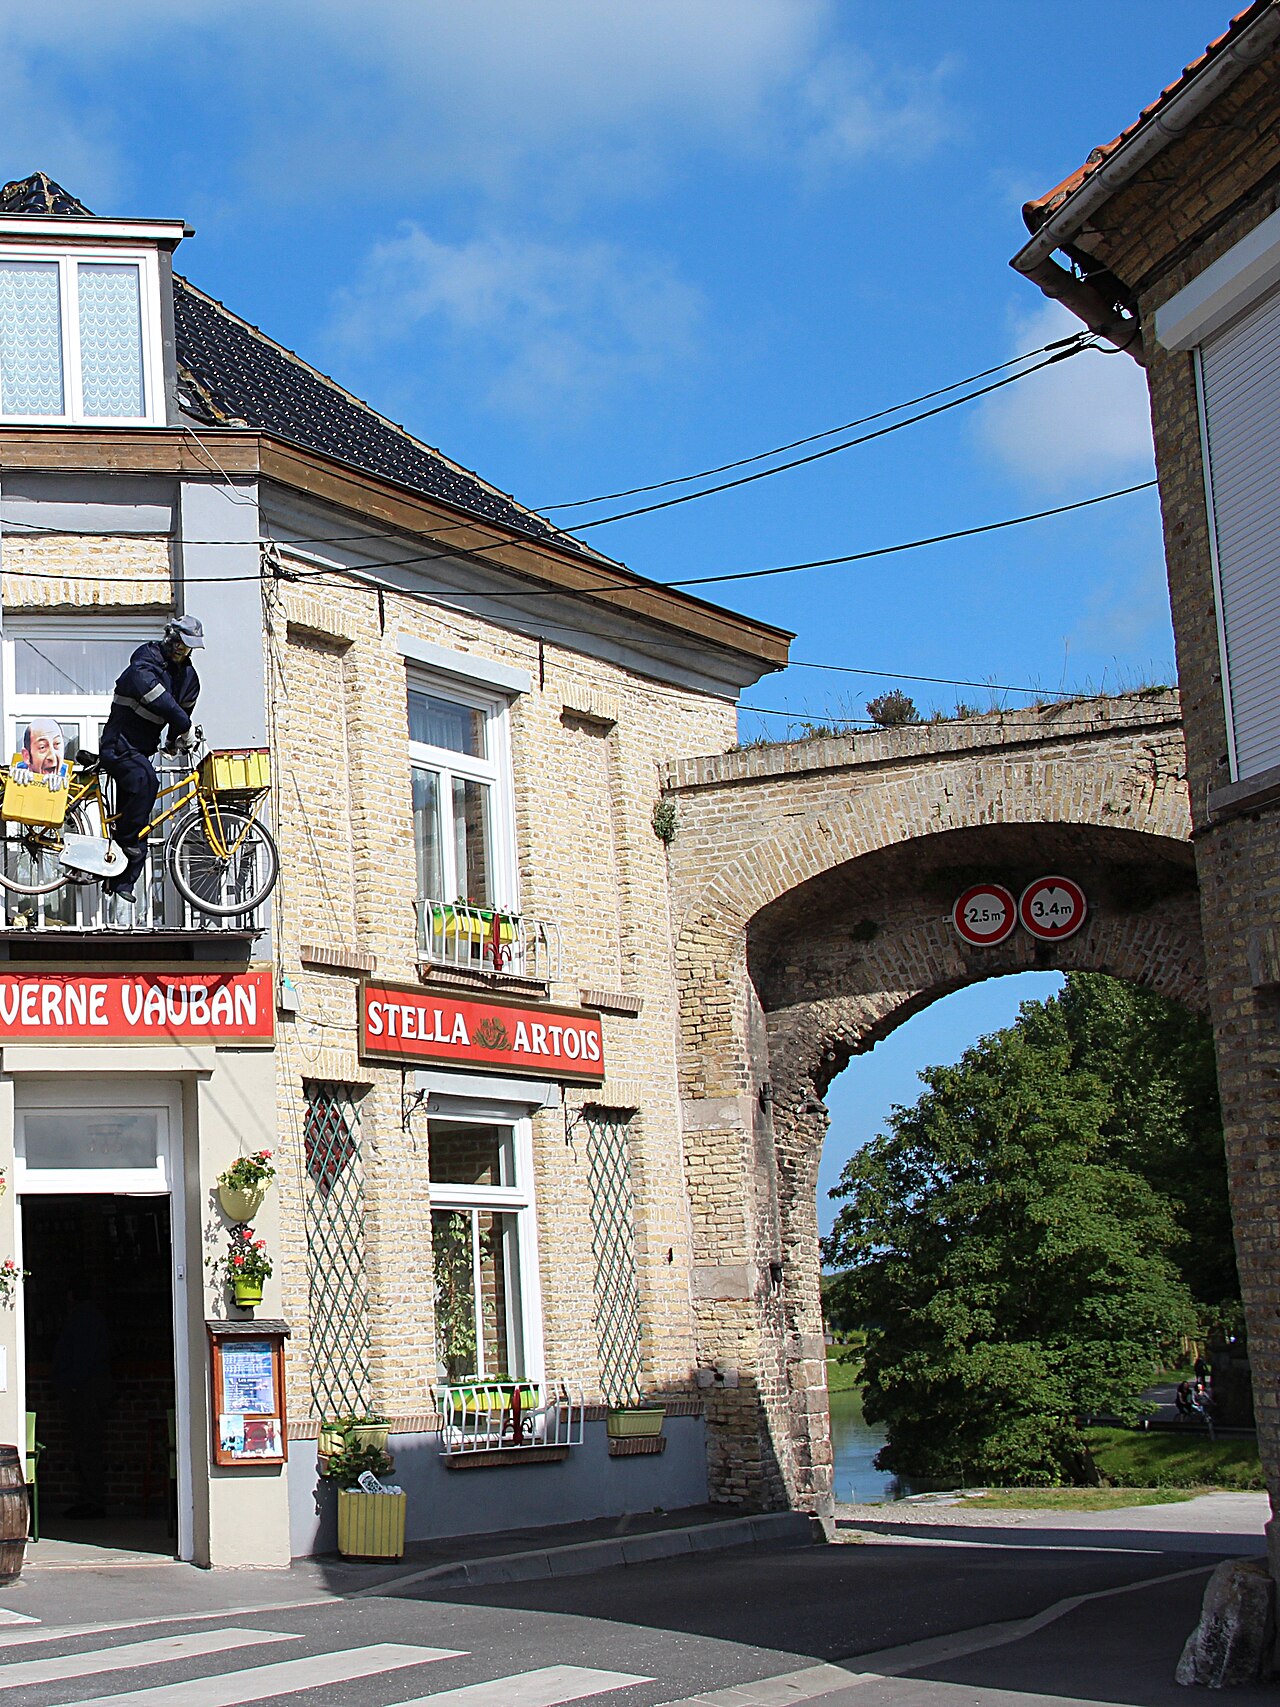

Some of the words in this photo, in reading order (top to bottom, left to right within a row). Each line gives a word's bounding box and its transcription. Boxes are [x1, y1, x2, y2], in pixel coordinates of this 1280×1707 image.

[121, 983, 257, 1026] VAUBAN
[367, 1000, 471, 1046] STELLA
[513, 1020, 601, 1062] ARTOIS
